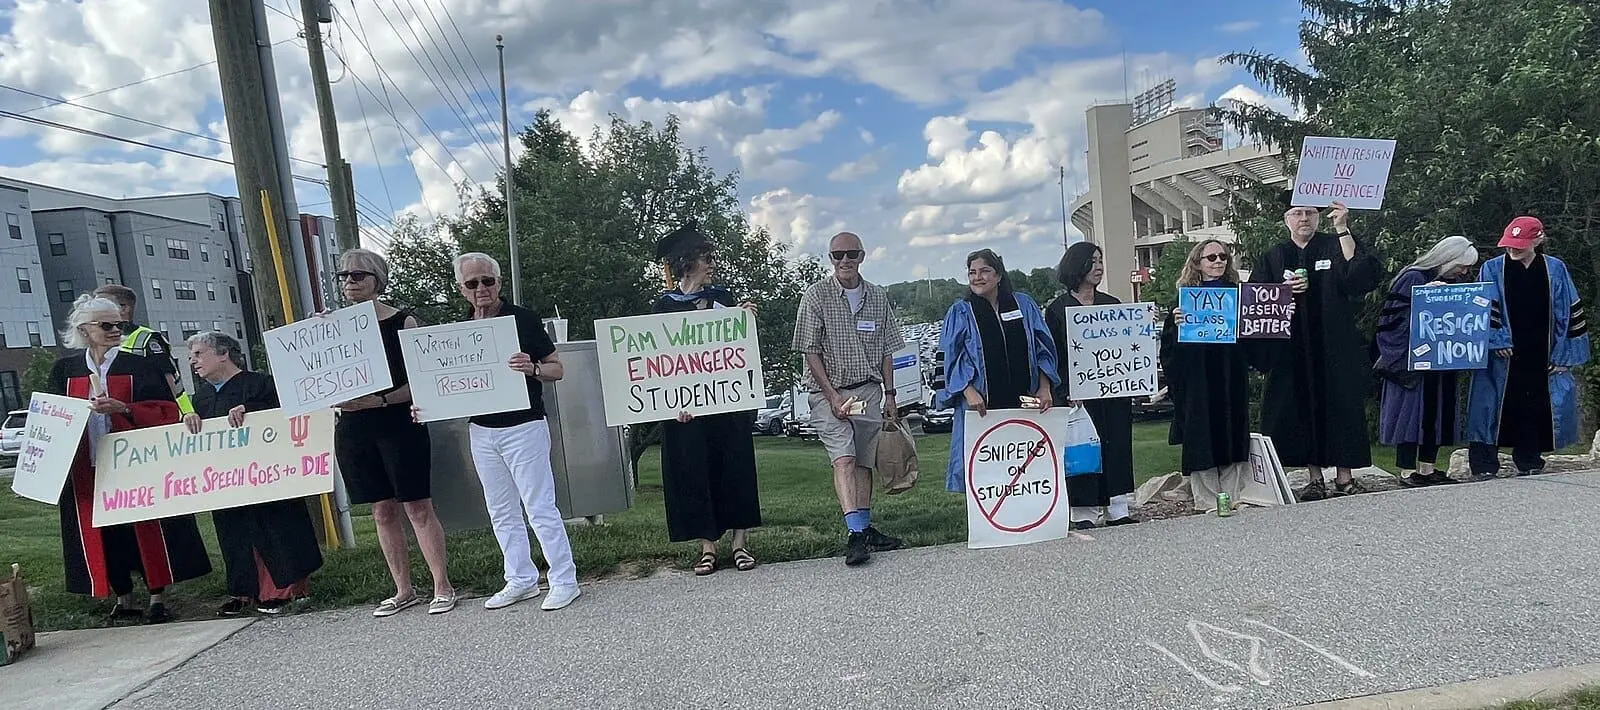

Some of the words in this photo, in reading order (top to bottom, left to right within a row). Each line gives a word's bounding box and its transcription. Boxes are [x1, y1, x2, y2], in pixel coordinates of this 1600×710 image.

[1304, 145, 1350, 160] WHITTEN
[1352, 148, 1391, 160] RESIGN
[1334, 163, 1355, 177] NO
[1298, 183, 1379, 198] CONFIDENCE!
[1189, 290, 1226, 312] YAY
[1252, 287, 1280, 303] YOU
[1073, 308, 1143, 325] CONGRATS
[1185, 313, 1225, 325] CLASS
[1241, 318, 1291, 336] BETTER
[1419, 310, 1489, 341] RESIGN
[277, 320, 342, 353] WRITTEN
[350, 314, 369, 334] TO
[415, 335, 461, 355] WRITTEN
[467, 331, 483, 346] TO
[610, 325, 658, 353] PAM
[662, 311, 748, 347] WHITTEN
[1082, 327, 1118, 340] CLASS
[300, 340, 363, 372] WHITTEN
[436, 348, 485, 368] WHITTEN
[1092, 348, 1122, 369] YOU
[1437, 340, 1484, 364] NOW
[627, 347, 747, 382] ENDANGERS
[1077, 356, 1151, 386] DESERVED
[300, 363, 368, 402] RESIGN
[438, 372, 490, 395] RESIGN
[628, 369, 756, 413] STUDENTS!
[1098, 374, 1154, 398] BETTER!
[113, 437, 159, 470] PAM
[165, 426, 250, 456] WHITTEN
[978, 440, 1046, 462] SNIPERS
[102, 485, 156, 511] WHERE
[163, 471, 199, 499] FREE
[202, 466, 245, 494] SPEECH
[248, 461, 281, 487] GOES
[301, 452, 330, 477] DIE
[1008, 465, 1026, 476] ON
[977, 480, 1052, 500] STUDENTS
